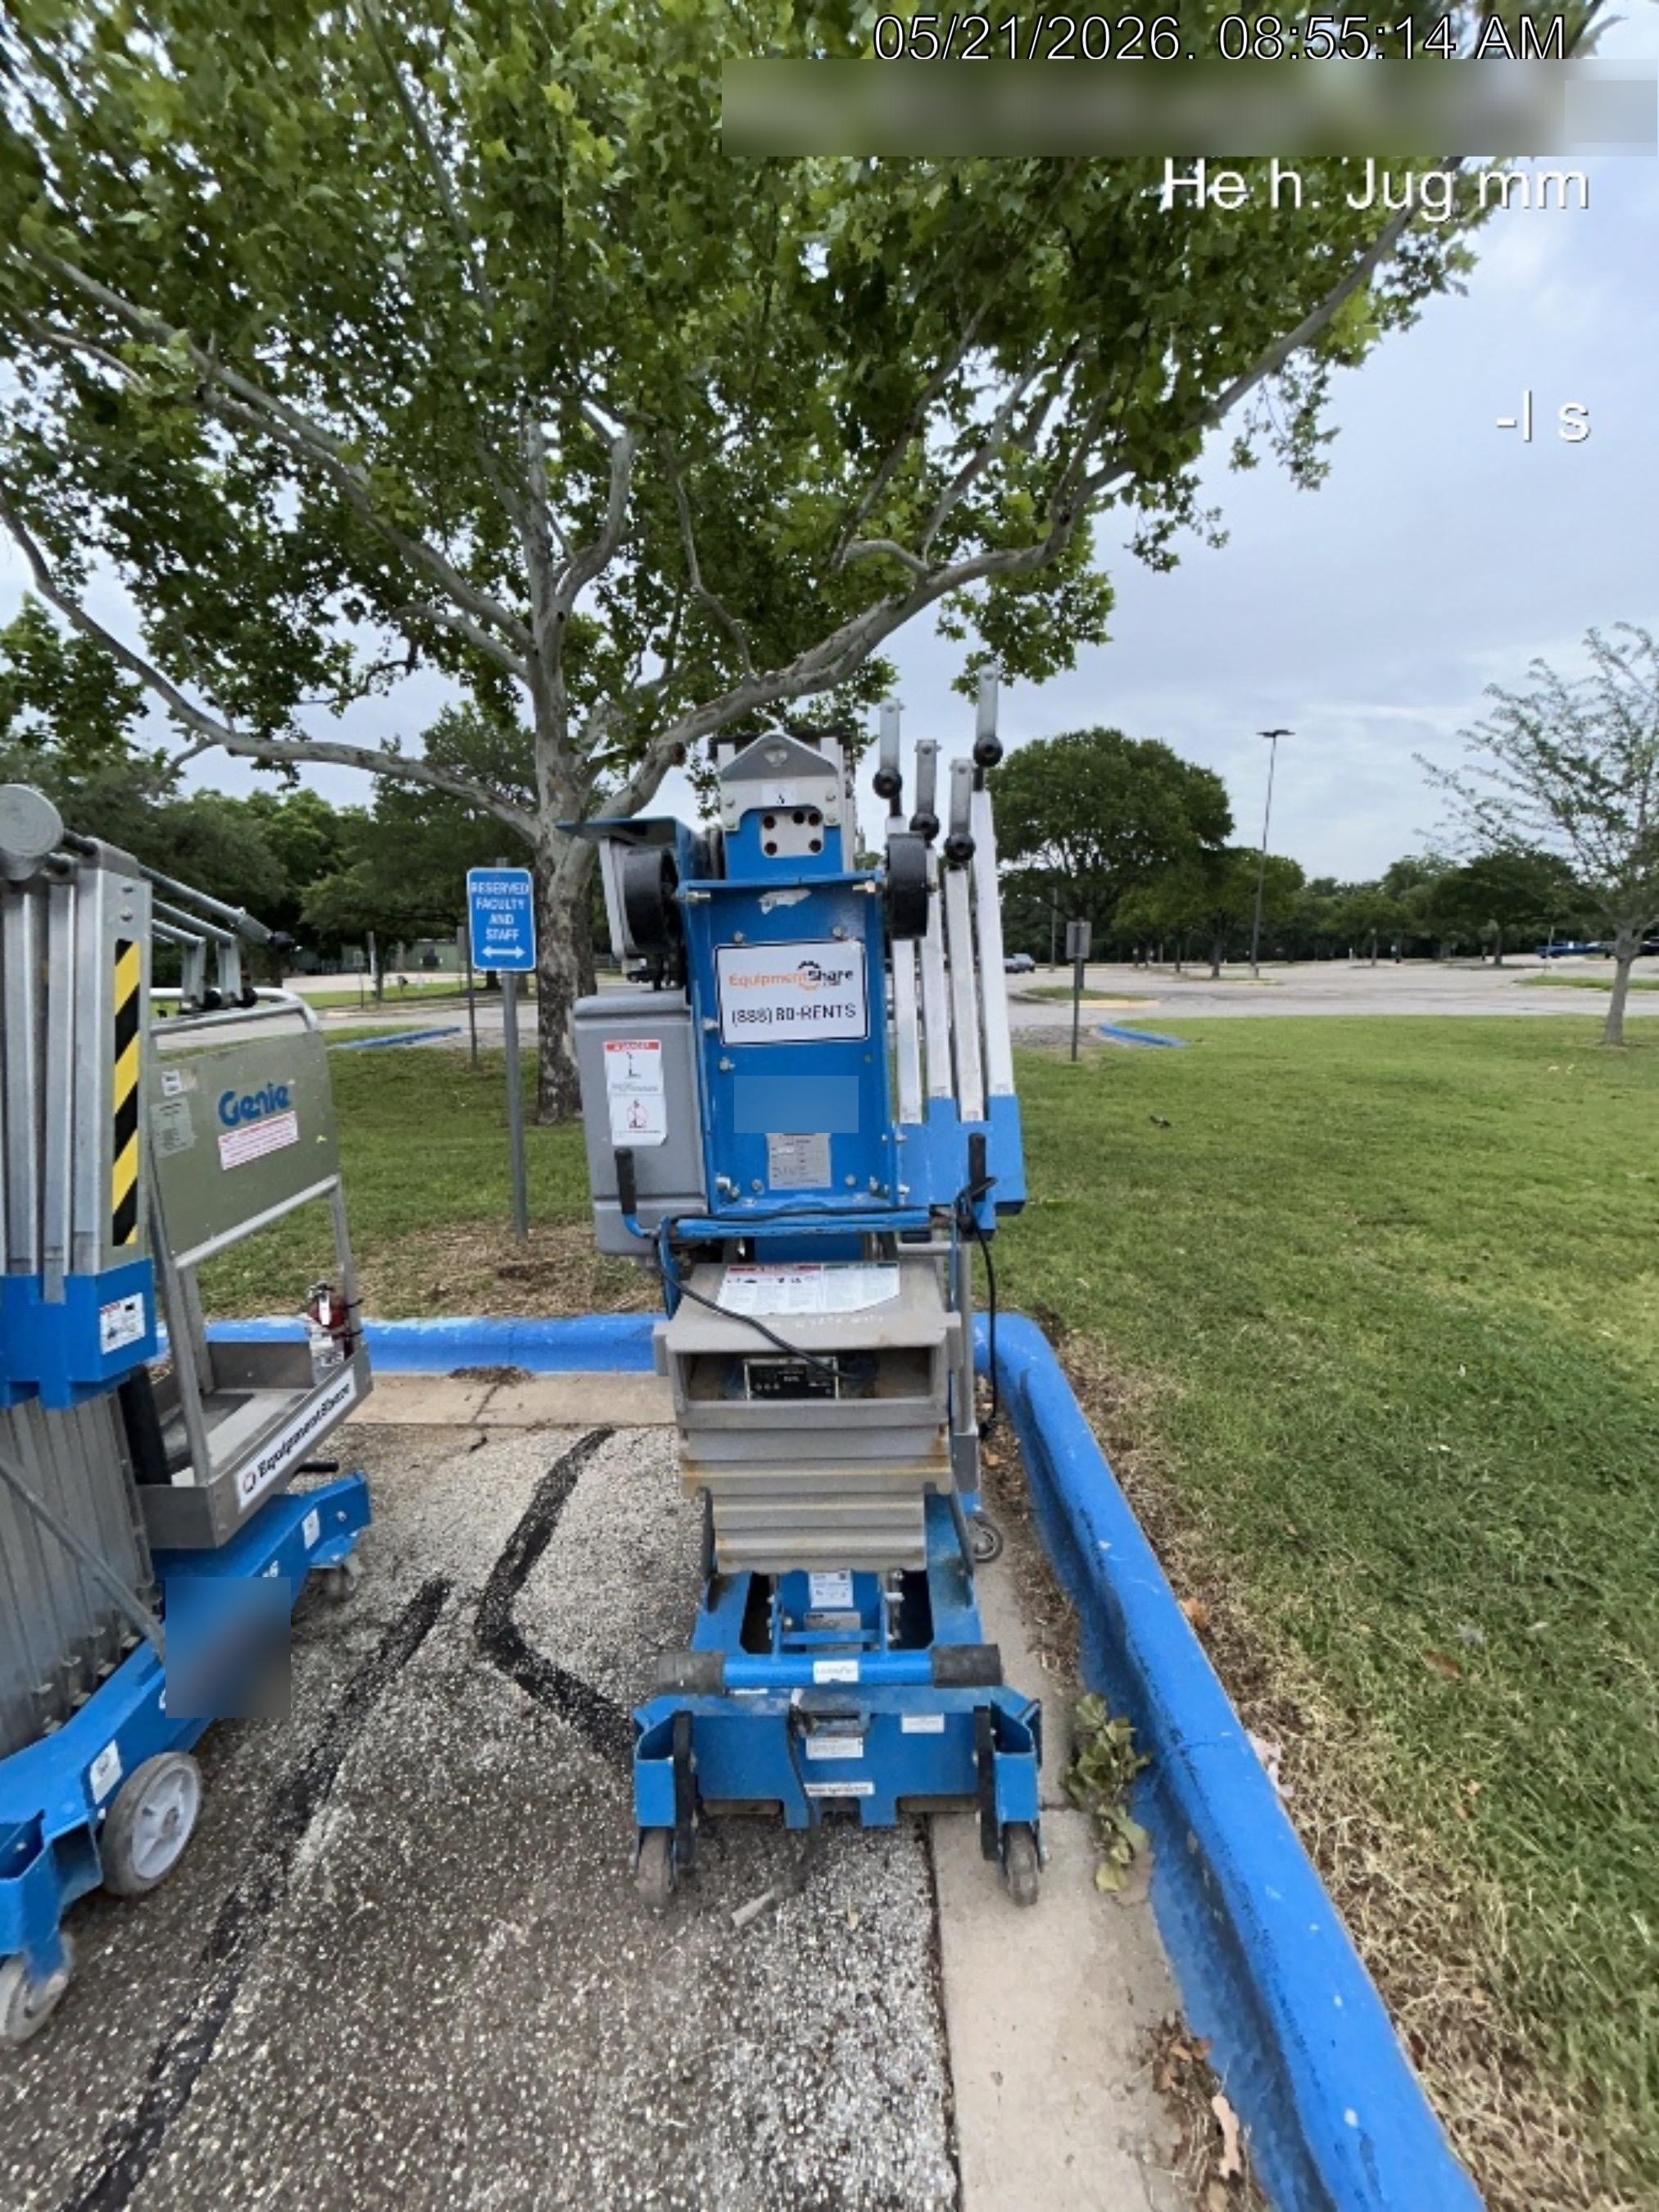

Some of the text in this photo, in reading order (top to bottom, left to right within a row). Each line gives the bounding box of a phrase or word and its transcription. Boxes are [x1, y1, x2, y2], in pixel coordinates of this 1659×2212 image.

[471, 882, 529, 895] RESERVED
[476, 896, 525, 910] FACULTY
[489, 913, 514, 925] AND
[486, 928, 519, 941] STAFF
[218, 1081, 290, 1127] Genie
